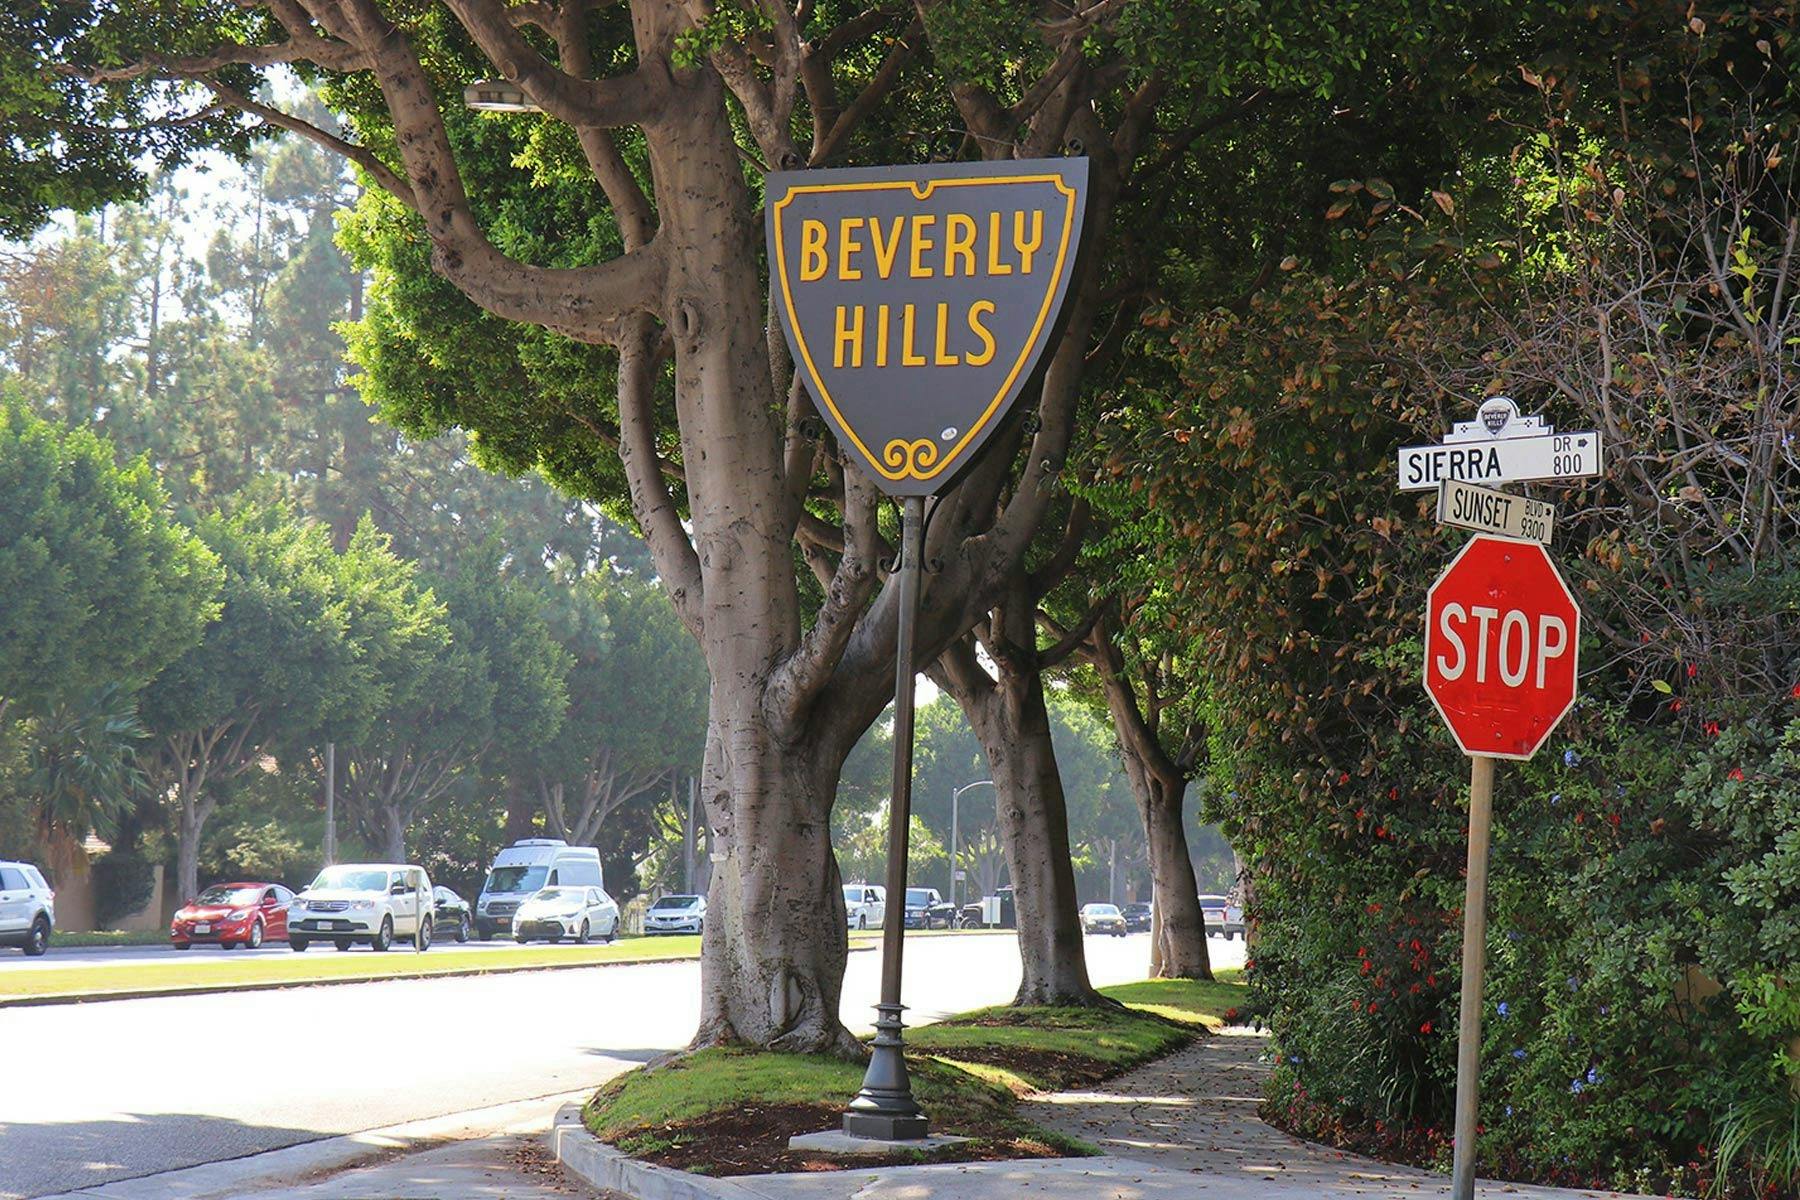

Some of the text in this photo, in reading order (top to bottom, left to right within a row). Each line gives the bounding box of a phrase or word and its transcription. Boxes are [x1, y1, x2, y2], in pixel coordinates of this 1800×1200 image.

[800, 210, 1043, 281] BEVERLY
[833, 300, 996, 368] HILLS
[1553, 437, 1571, 452] DR
[1408, 447, 1502, 484] SIERRA
[1553, 453, 1582, 475] 800
[1453, 488, 1512, 529] SUNSET
[1525, 500, 1543, 517] BLVD
[1520, 517, 1545, 541] 9300
[1436, 602, 1568, 689] STOP
